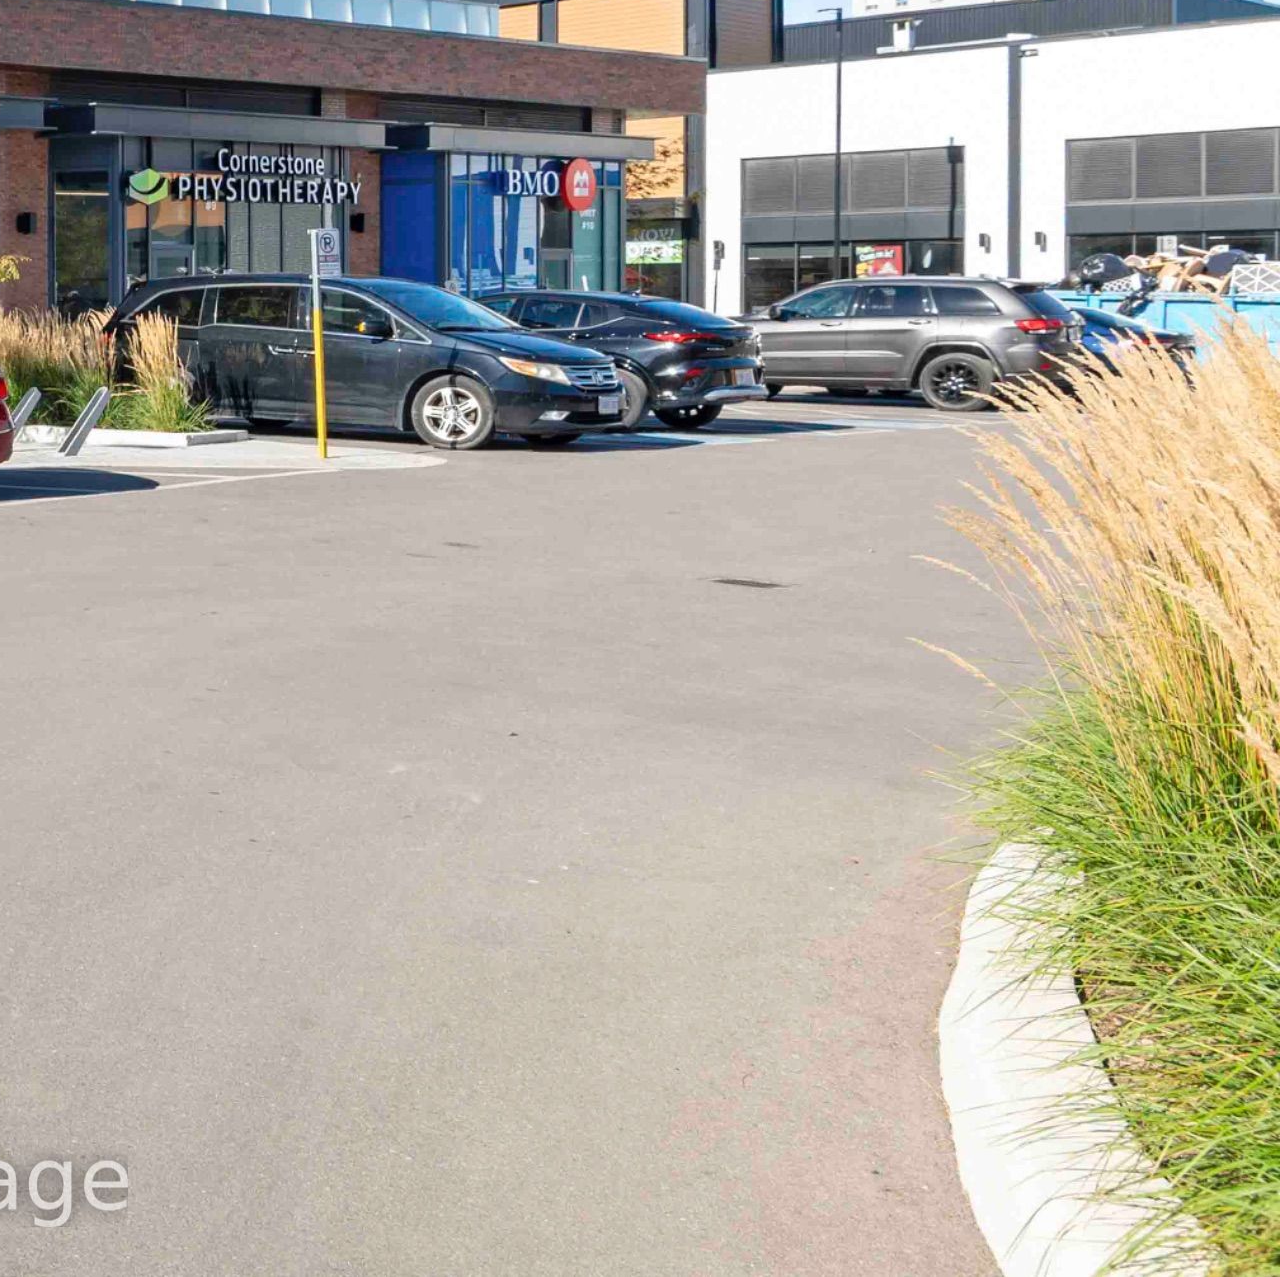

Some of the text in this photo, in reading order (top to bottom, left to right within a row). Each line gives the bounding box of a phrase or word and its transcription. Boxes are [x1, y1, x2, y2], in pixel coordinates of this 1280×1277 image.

[217, 148, 325, 176] Cornerstone
[178, 176, 362, 205] PHYSIOTHERAPY
[507, 169, 560, 197] BMO
